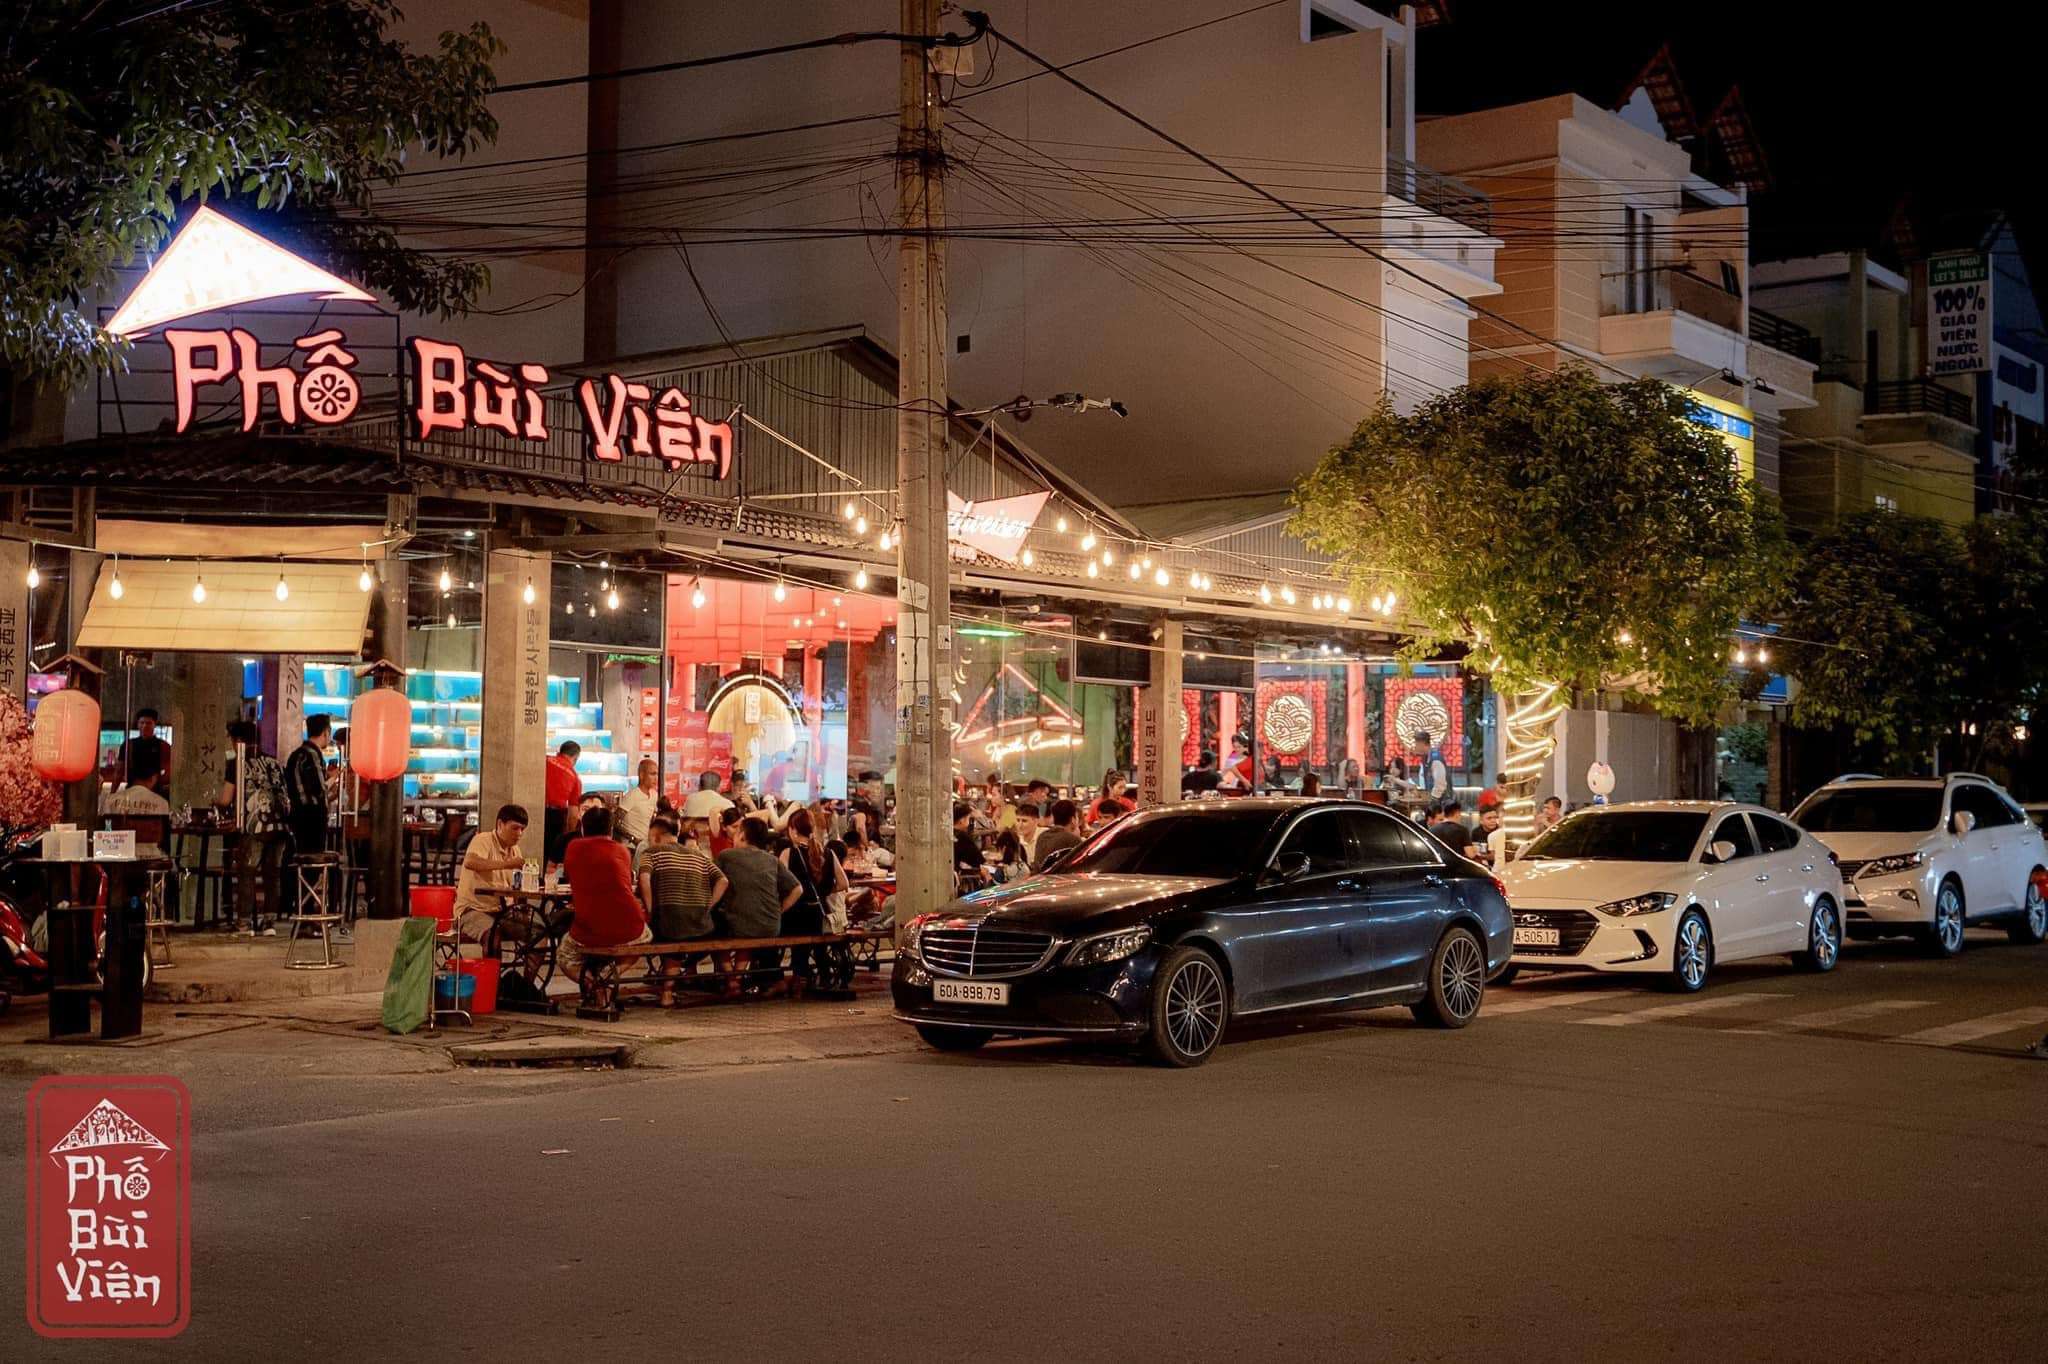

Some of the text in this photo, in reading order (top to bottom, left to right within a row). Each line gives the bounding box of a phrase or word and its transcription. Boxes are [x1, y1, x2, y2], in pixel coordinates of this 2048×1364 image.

[1933, 285, 1985, 314] 100%
[164, 328, 735, 481] Phố Bùi Viện
[948, 511, 1029, 538] dweiser
[286, 655, 298, 711] フランス
[524, 670, 540, 726] 행복한
[1144, 709, 1157, 738] 코드
[1515, 930, 1558, 944] A-505.12
[939, 984, 1001, 1001] 60A-898.79
